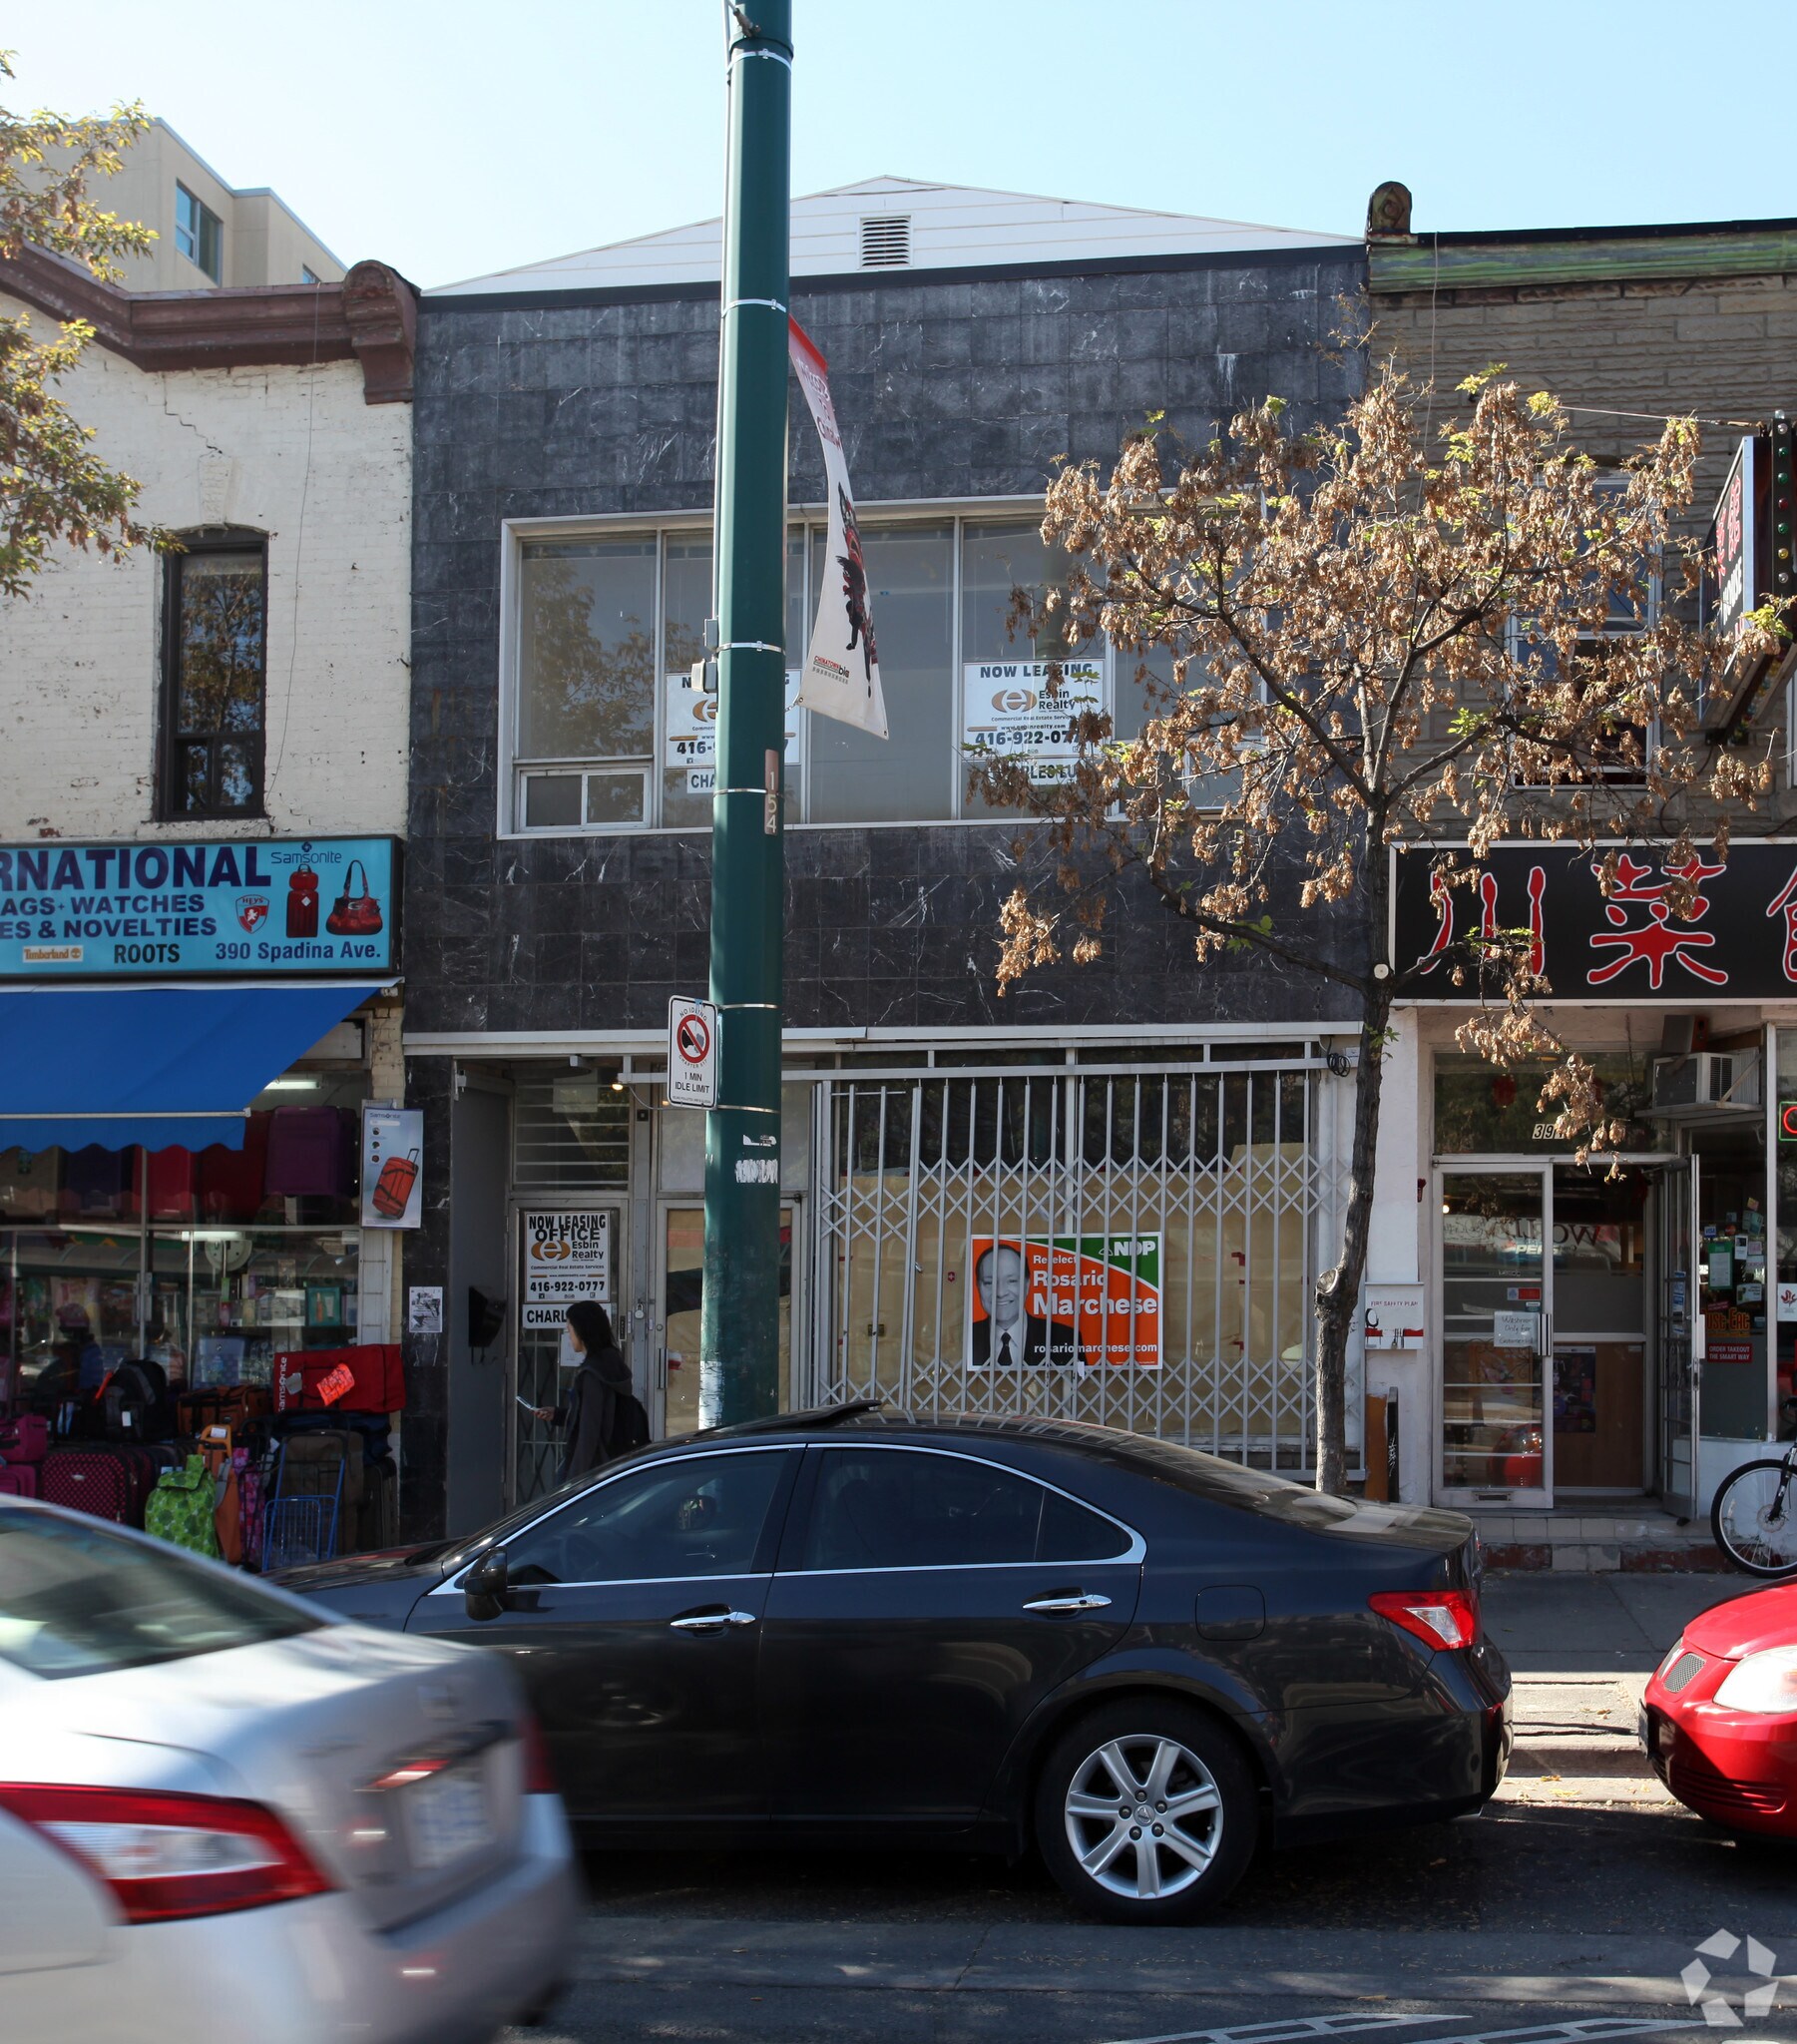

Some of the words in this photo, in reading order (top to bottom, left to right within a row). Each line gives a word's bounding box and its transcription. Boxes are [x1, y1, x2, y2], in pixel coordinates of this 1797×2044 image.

[980, 666, 1017, 679] NOW
[1023, 664, 1093, 678] LEING
[1039, 689, 1070, 700] Esin
[1039, 700, 1076, 711] Realty
[976, 731, 1079, 746] 416-922-07
[271, 850, 342, 864] Samsonite
[70, 894, 206, 915] WATCHES
[0, 919, 32, 939] ES
[38, 920, 57, 939] &
[64, 917, 218, 938] NOVELTIES
[23, 947, 70, 961] Timberland
[114, 943, 181, 964] ROOTS
[216, 942, 251, 960] 390
[257, 941, 334, 963] Spadina
[340, 941, 381, 959] Ave.
[679, 1008, 688, 1017] NO
[689, 1007, 707, 1021] IDLING
[678, 1055, 698, 1069] CHAPTER
[675, 1082, 690, 1091] IDLE
[692, 1084, 709, 1093] LIMIT
[1534, 1125, 1564, 1139] 39
[529, 1215, 555, 1230] NOW
[559, 1214, 606, 1229] LEASING
[535, 1228, 601, 1242] OFFICE
[572, 1241, 599, 1250] Esbin
[572, 1250, 605, 1261] Realty
[1034, 1255, 1077, 1265] Reelect
[1034, 1270, 1106, 1286] Rosario
[530, 1280, 605, 1292] 416-922-0777
[1033, 1292, 1157, 1315] Marchese
[1034, 1343, 1157, 1353] roariomarchesecom
